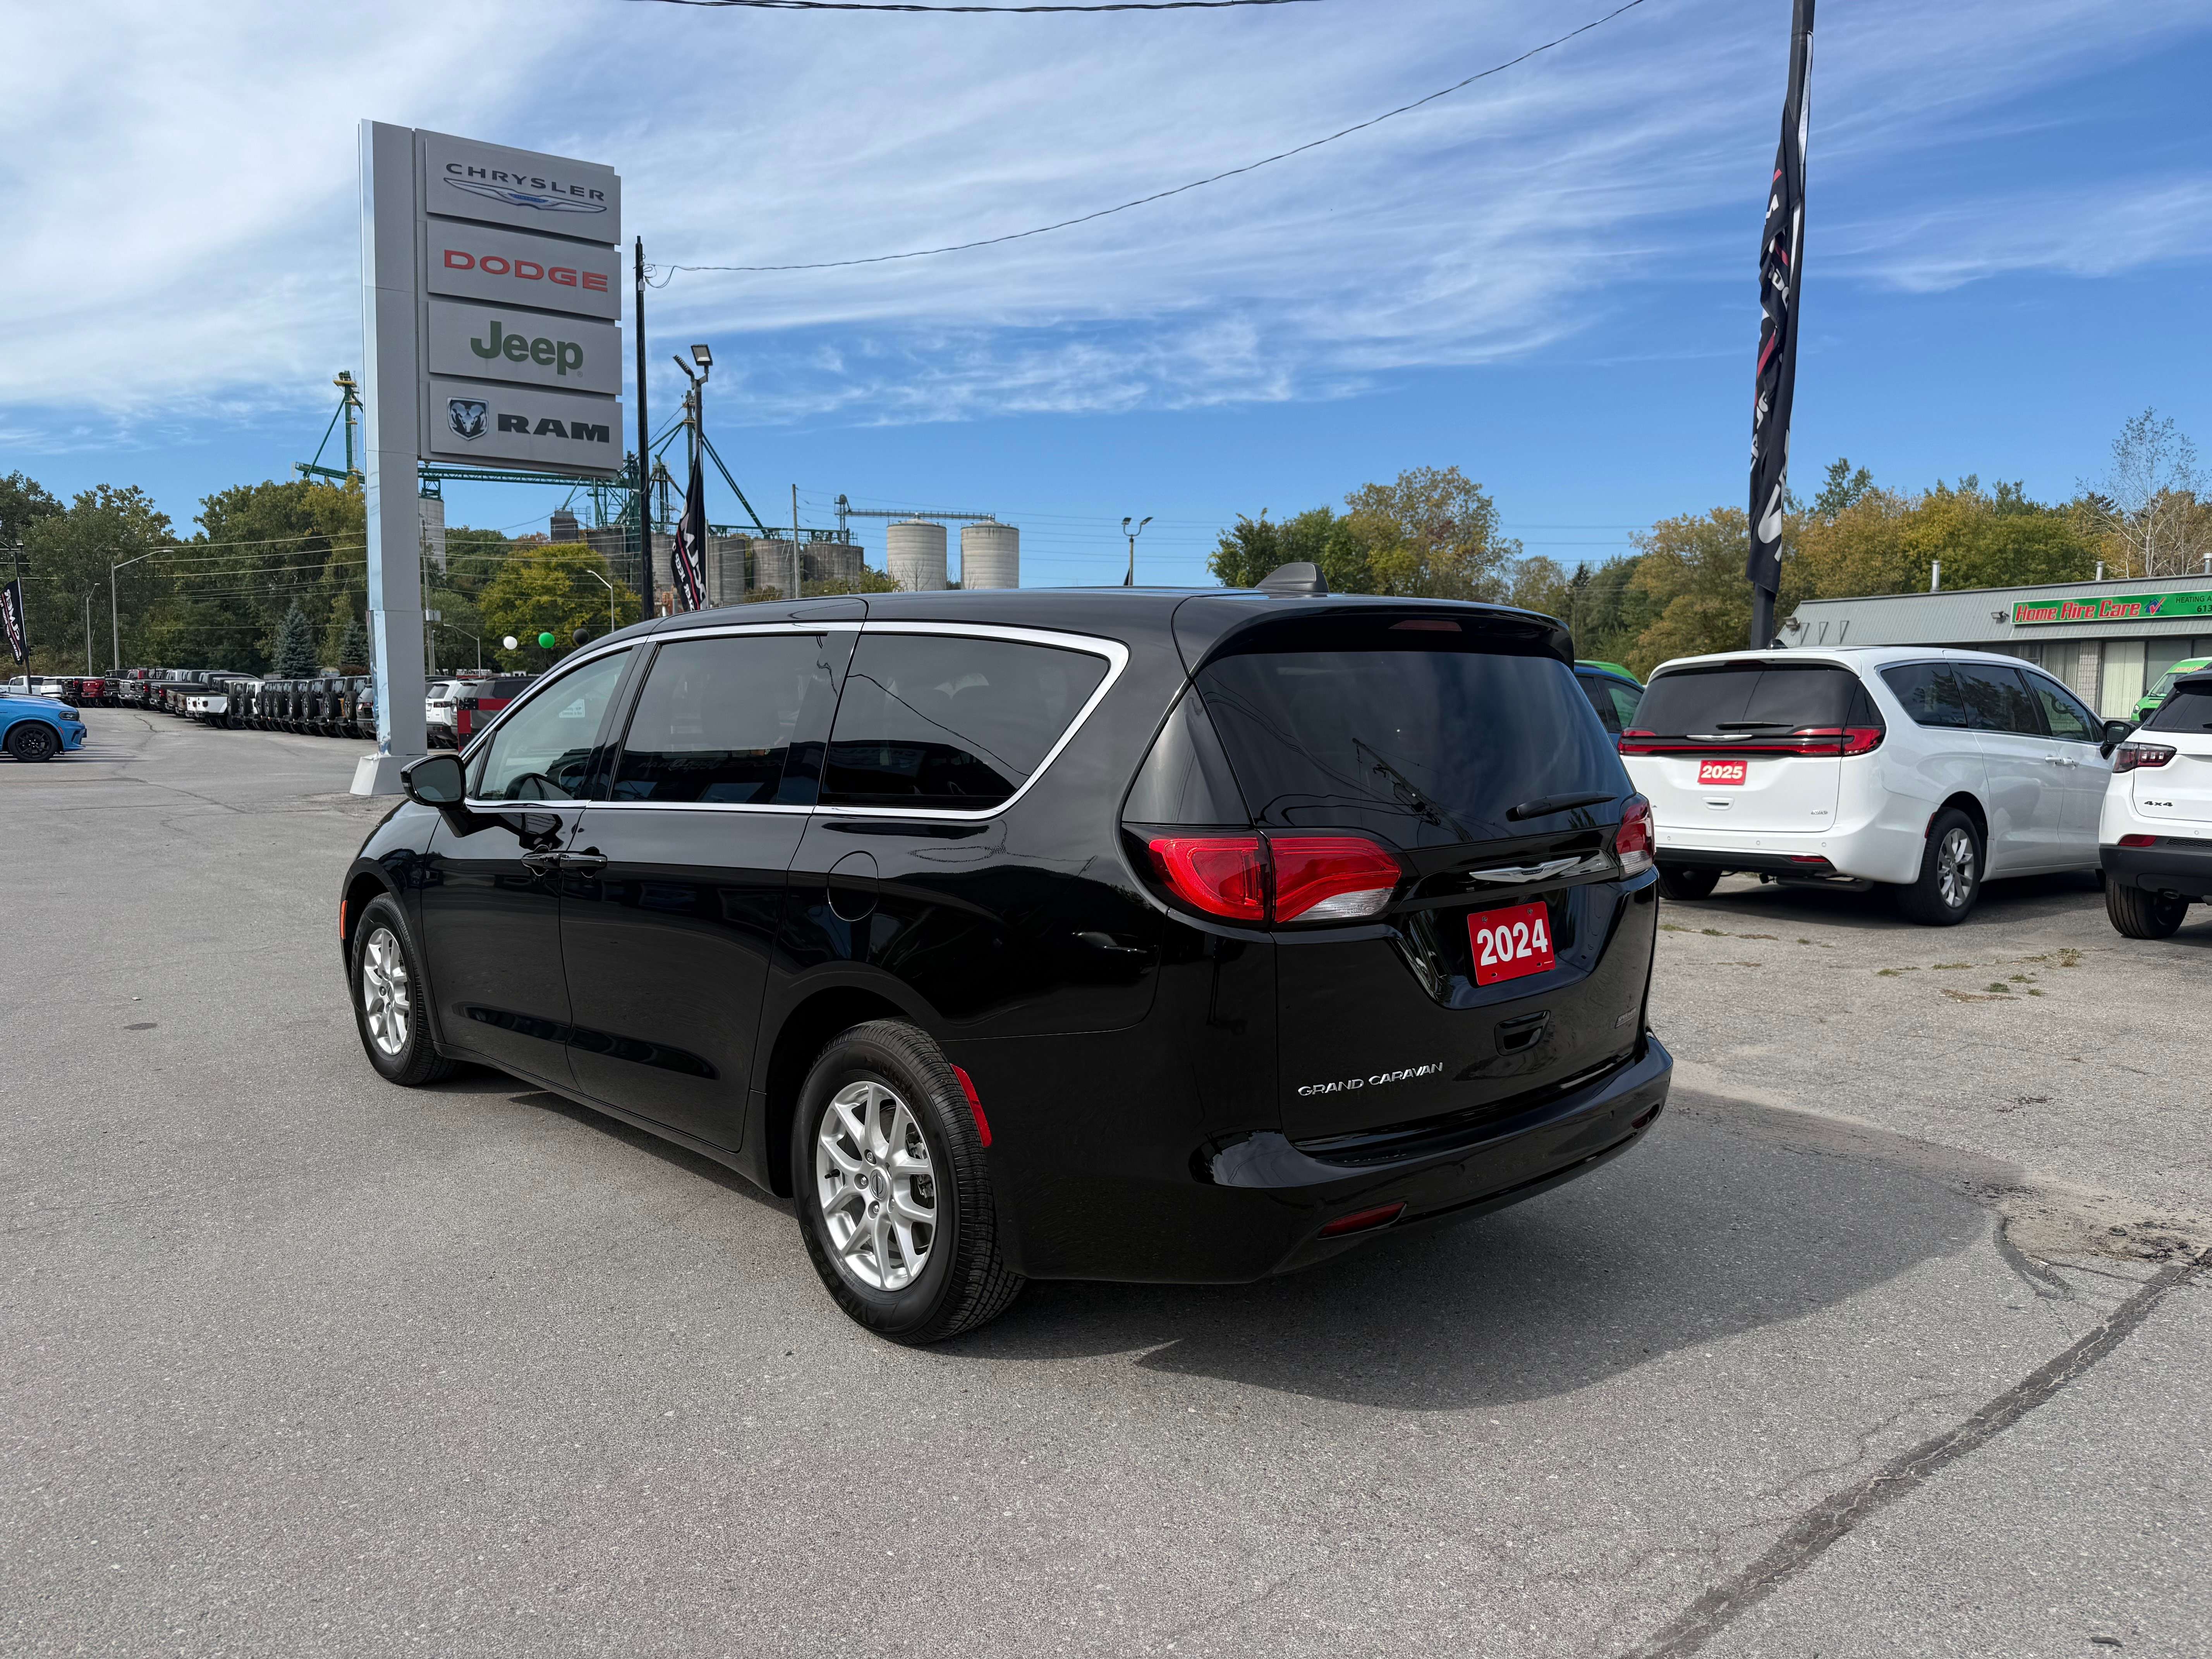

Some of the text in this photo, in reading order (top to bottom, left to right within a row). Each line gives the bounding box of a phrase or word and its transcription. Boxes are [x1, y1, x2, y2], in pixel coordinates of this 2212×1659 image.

[446, 163, 605, 201] CHRYSLER
[445, 249, 608, 293] DODGE
[470, 320, 584, 376] Jeep
[498, 413, 610, 443] RAM
[2015, 599, 2141, 622] Home Aire Care
[1701, 765, 1743, 779] 2025
[1477, 919, 1548, 966] 2024
[1298, 1062, 1443, 1096] GRAND CARAVAN
